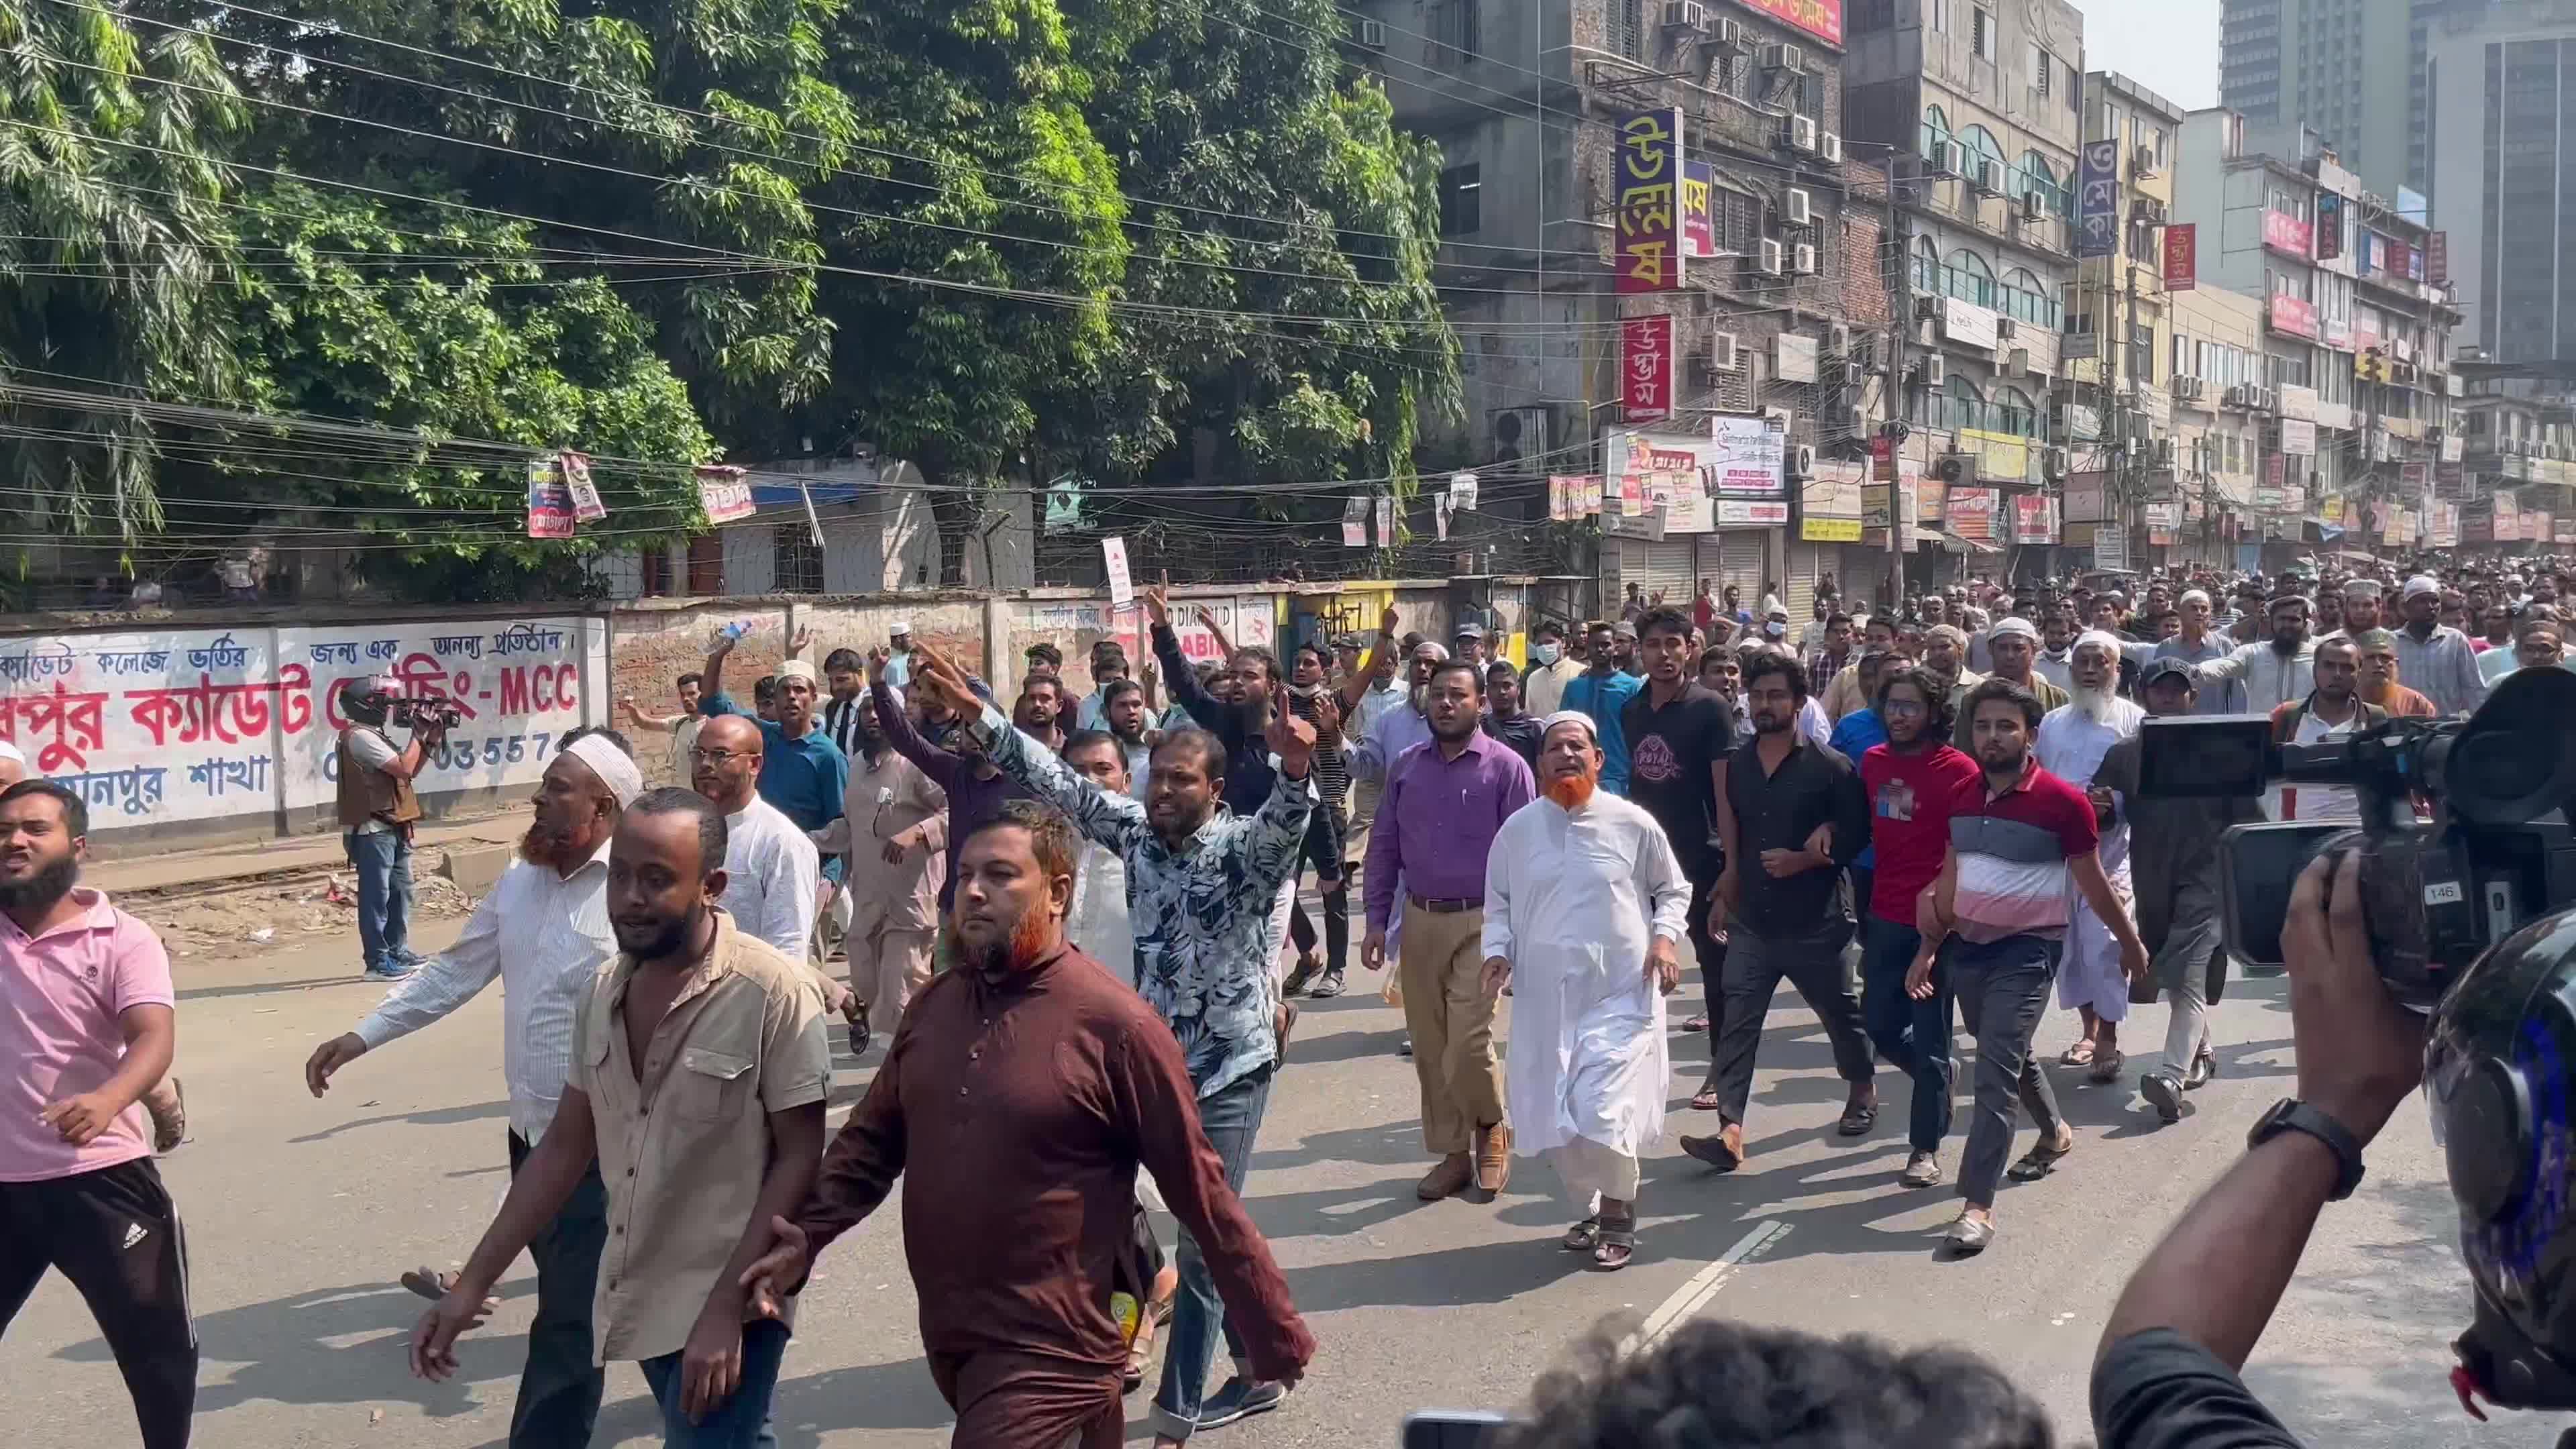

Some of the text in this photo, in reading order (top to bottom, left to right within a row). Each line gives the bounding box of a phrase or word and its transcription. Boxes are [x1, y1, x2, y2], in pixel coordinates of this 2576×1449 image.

[96, 651, 170, 675] কলেজে
[187, 633, 249, 672] ভর্তির
[310, 643, 358, 665] জন্য
[366, 639, 400, 659] এক
[430, 635, 484, 660] অনন্য
[488, 625, 564, 656] প্রতিষ্ঠান
[123, 663, 311, 746] ক্যাডেট
[186, 755, 272, 797] শাখা
[2431, 885, 2454, 900] 146
